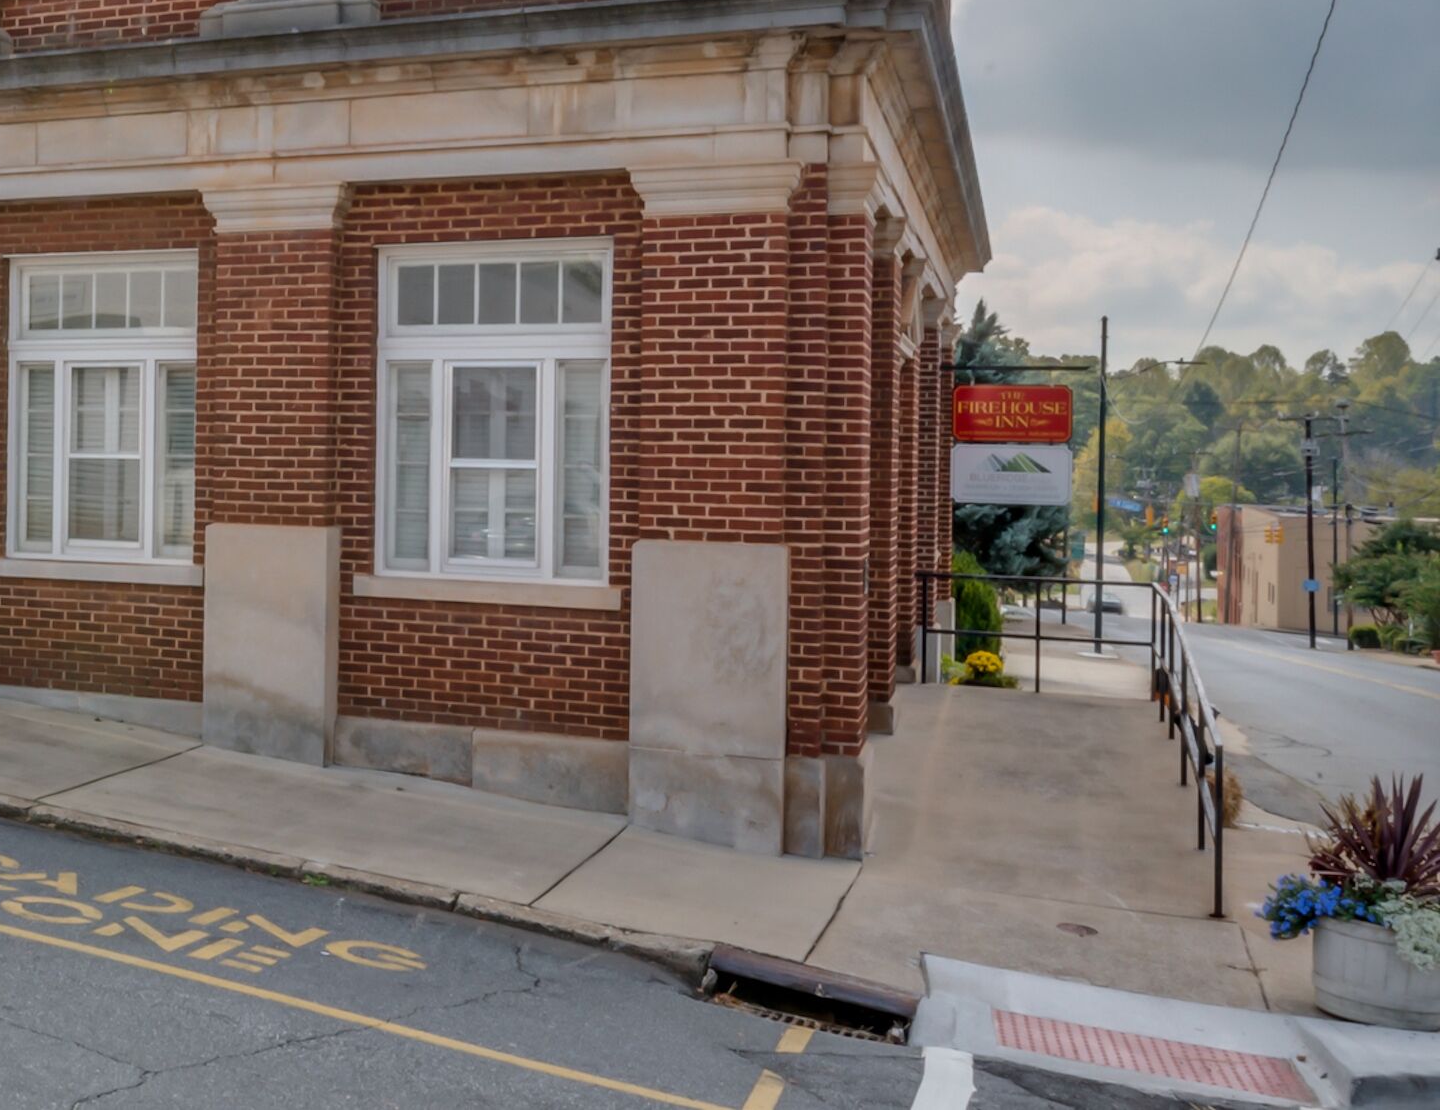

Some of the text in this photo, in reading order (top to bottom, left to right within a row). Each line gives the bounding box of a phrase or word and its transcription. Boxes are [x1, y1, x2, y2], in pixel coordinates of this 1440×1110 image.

[1000, 391, 1025, 400] THE
[957, 401, 1068, 415] FIREHOUSE
[995, 415, 1030, 428] INN
